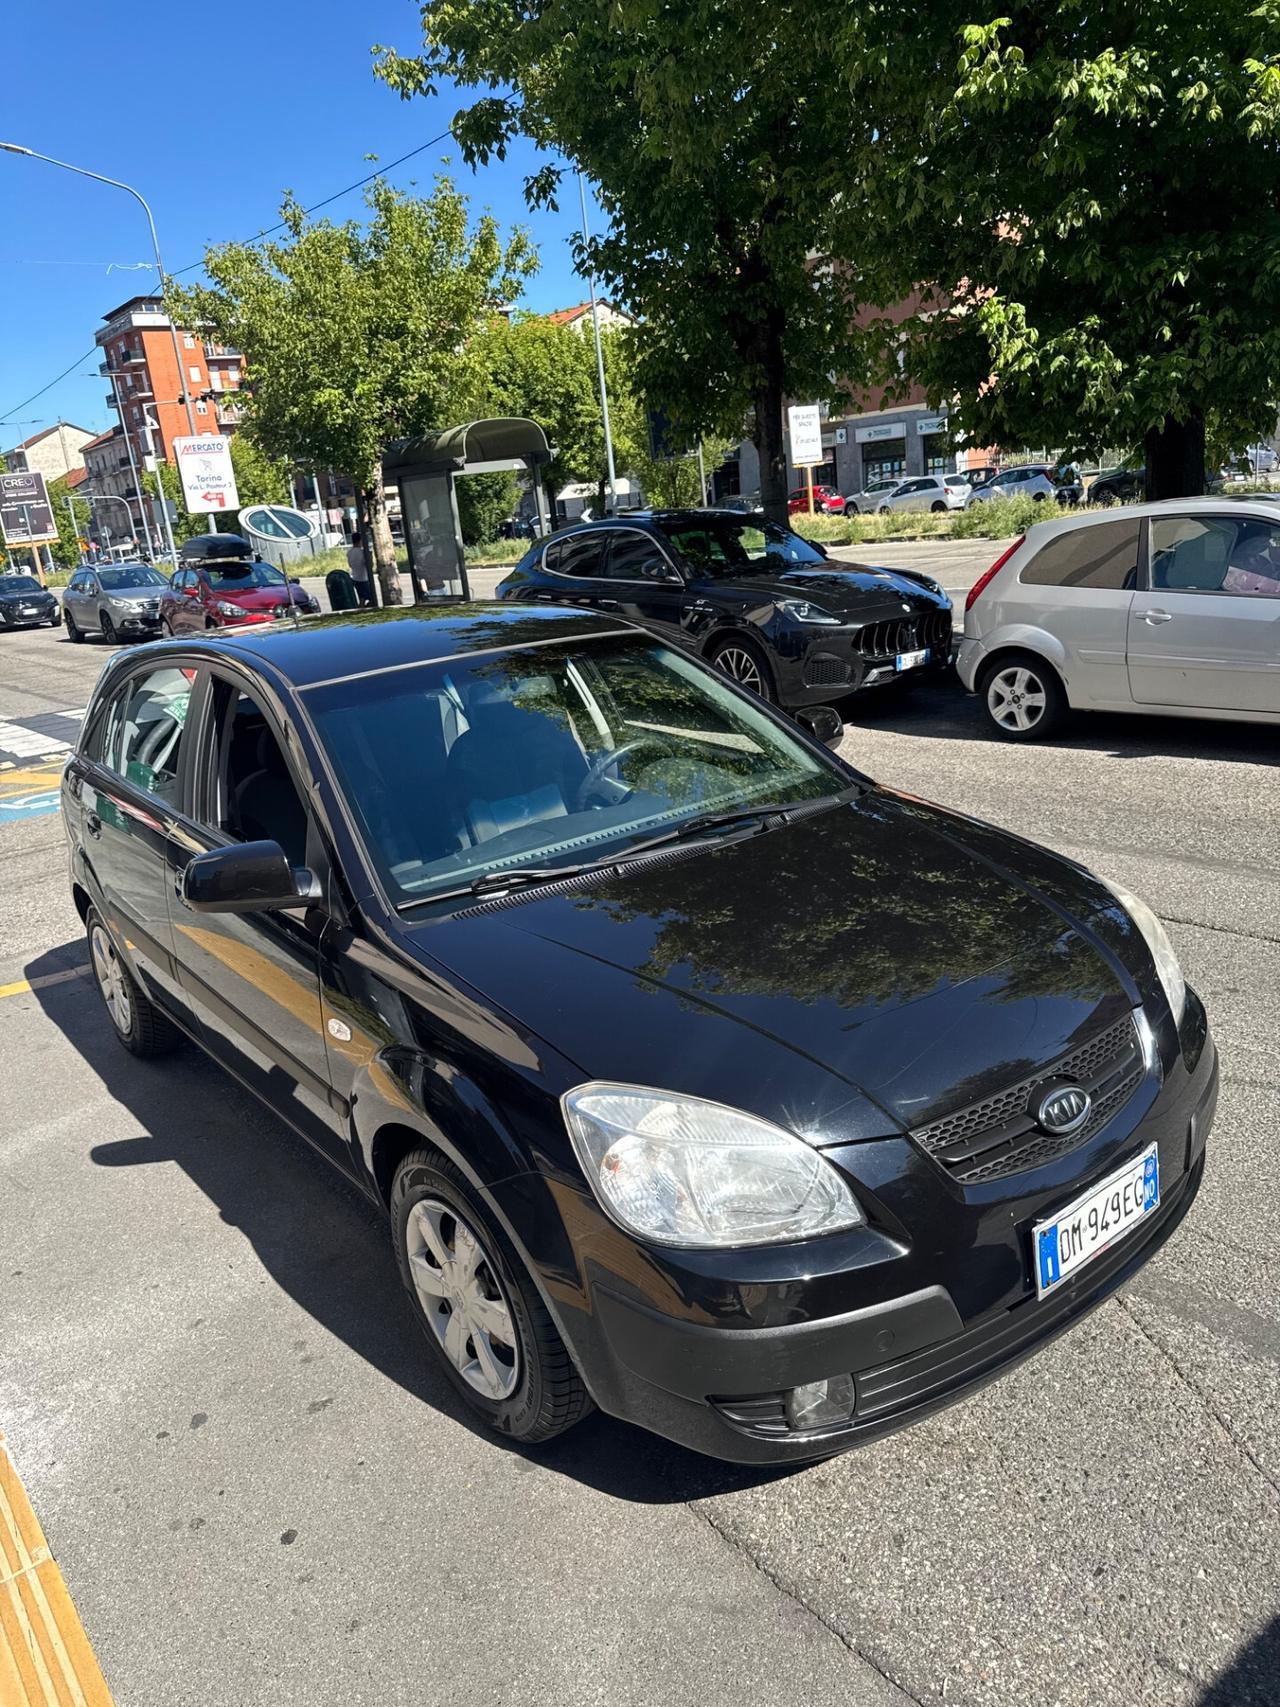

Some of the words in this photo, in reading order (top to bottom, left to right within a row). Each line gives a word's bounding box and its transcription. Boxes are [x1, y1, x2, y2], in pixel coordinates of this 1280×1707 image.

[4, 478, 32, 488] CREO
[196, 474, 222, 483] Torino
[1047, 1092, 1084, 1126] KIA
